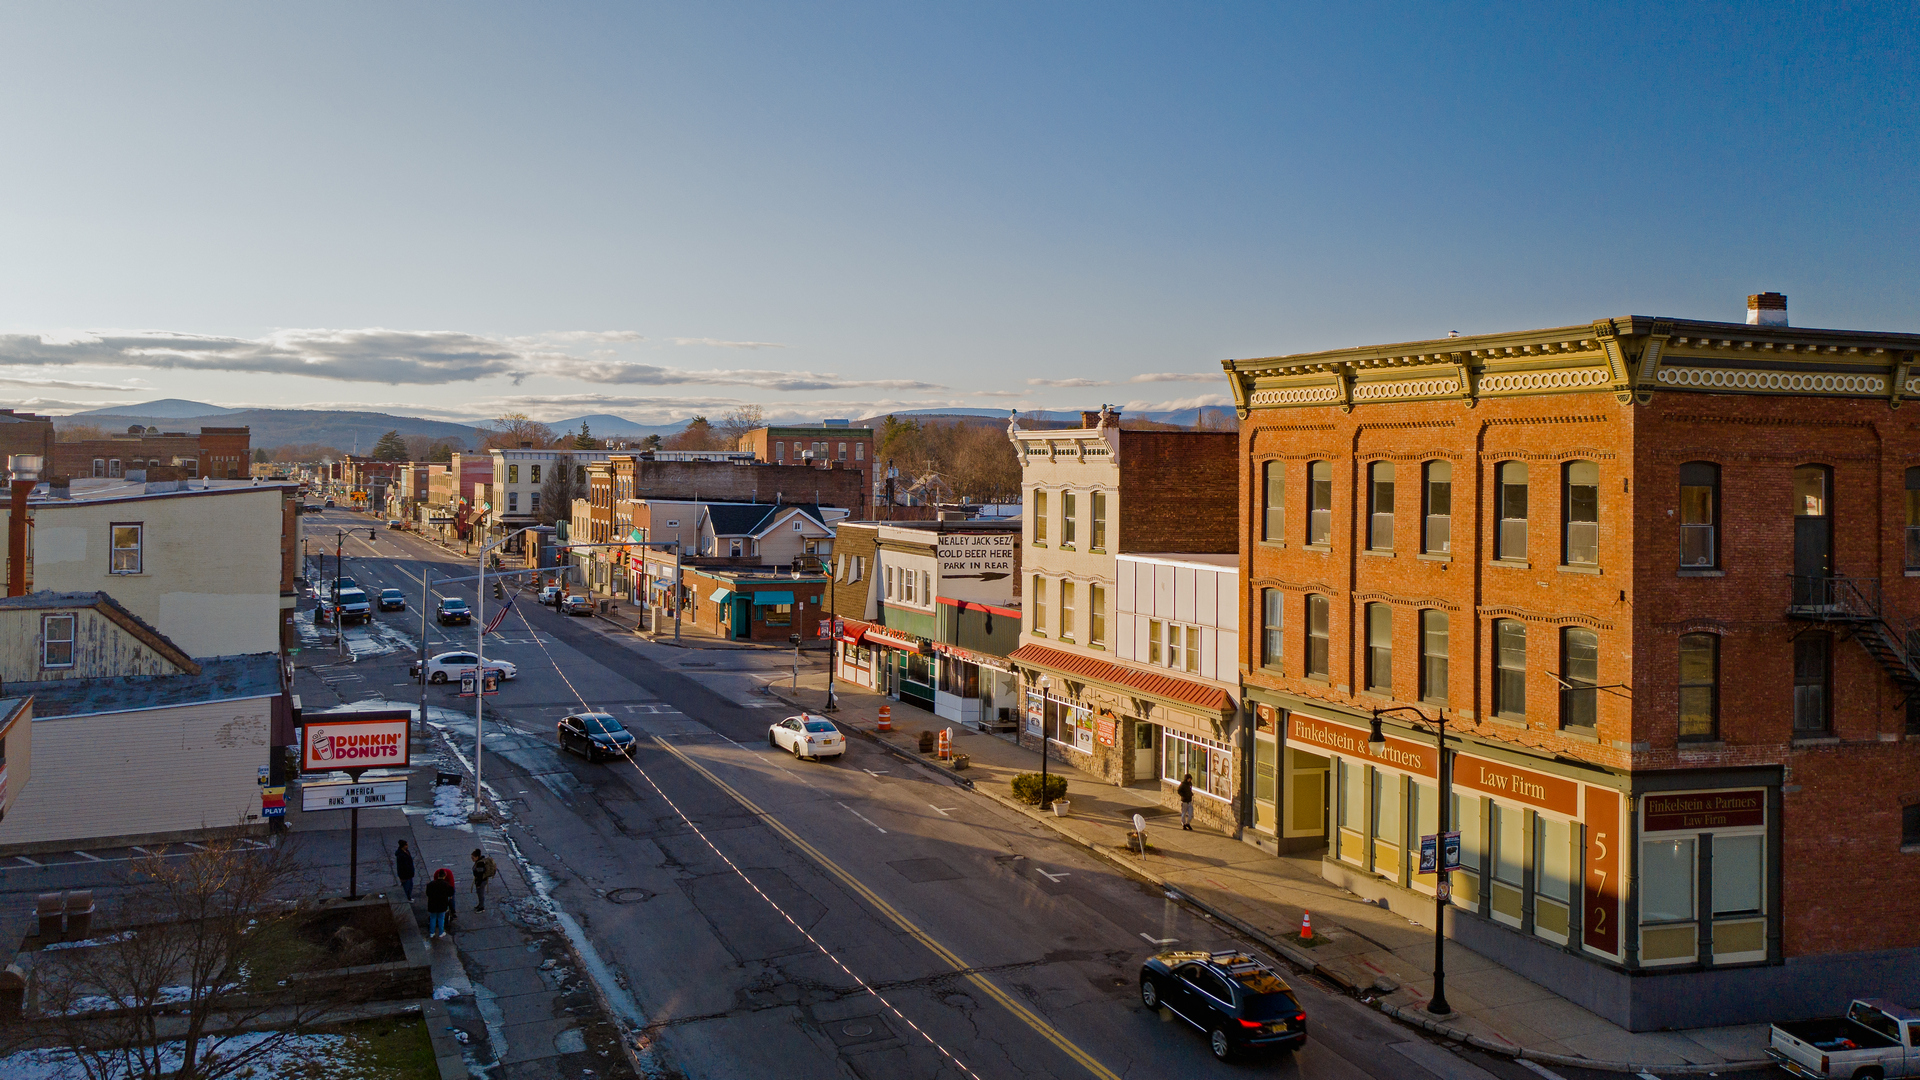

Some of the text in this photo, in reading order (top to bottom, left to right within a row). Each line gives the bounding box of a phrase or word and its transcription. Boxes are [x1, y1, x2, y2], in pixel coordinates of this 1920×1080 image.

[938, 536, 970, 546] NEALEY
[972, 536, 991, 546] JACK
[938, 550, 1012, 558] COLD BEER HERE
[336, 733, 402, 748] DUNKIN'
[1294, 720, 1354, 752] Finkelstein
[1357, 740, 1366, 754] &
[1368, 746, 1422, 768] rtners
[335, 745, 398, 760] DONUTS
[1480, 766, 1546, 800] Law Firm
[346, 787, 374, 796] AMERICA
[328, 797, 344, 806] RUNS
[364, 794, 386, 802] DUNKIN
[1648, 796, 1756, 812] Finkelstein & Partners
[1683, 814, 1726, 826] Law Firm
